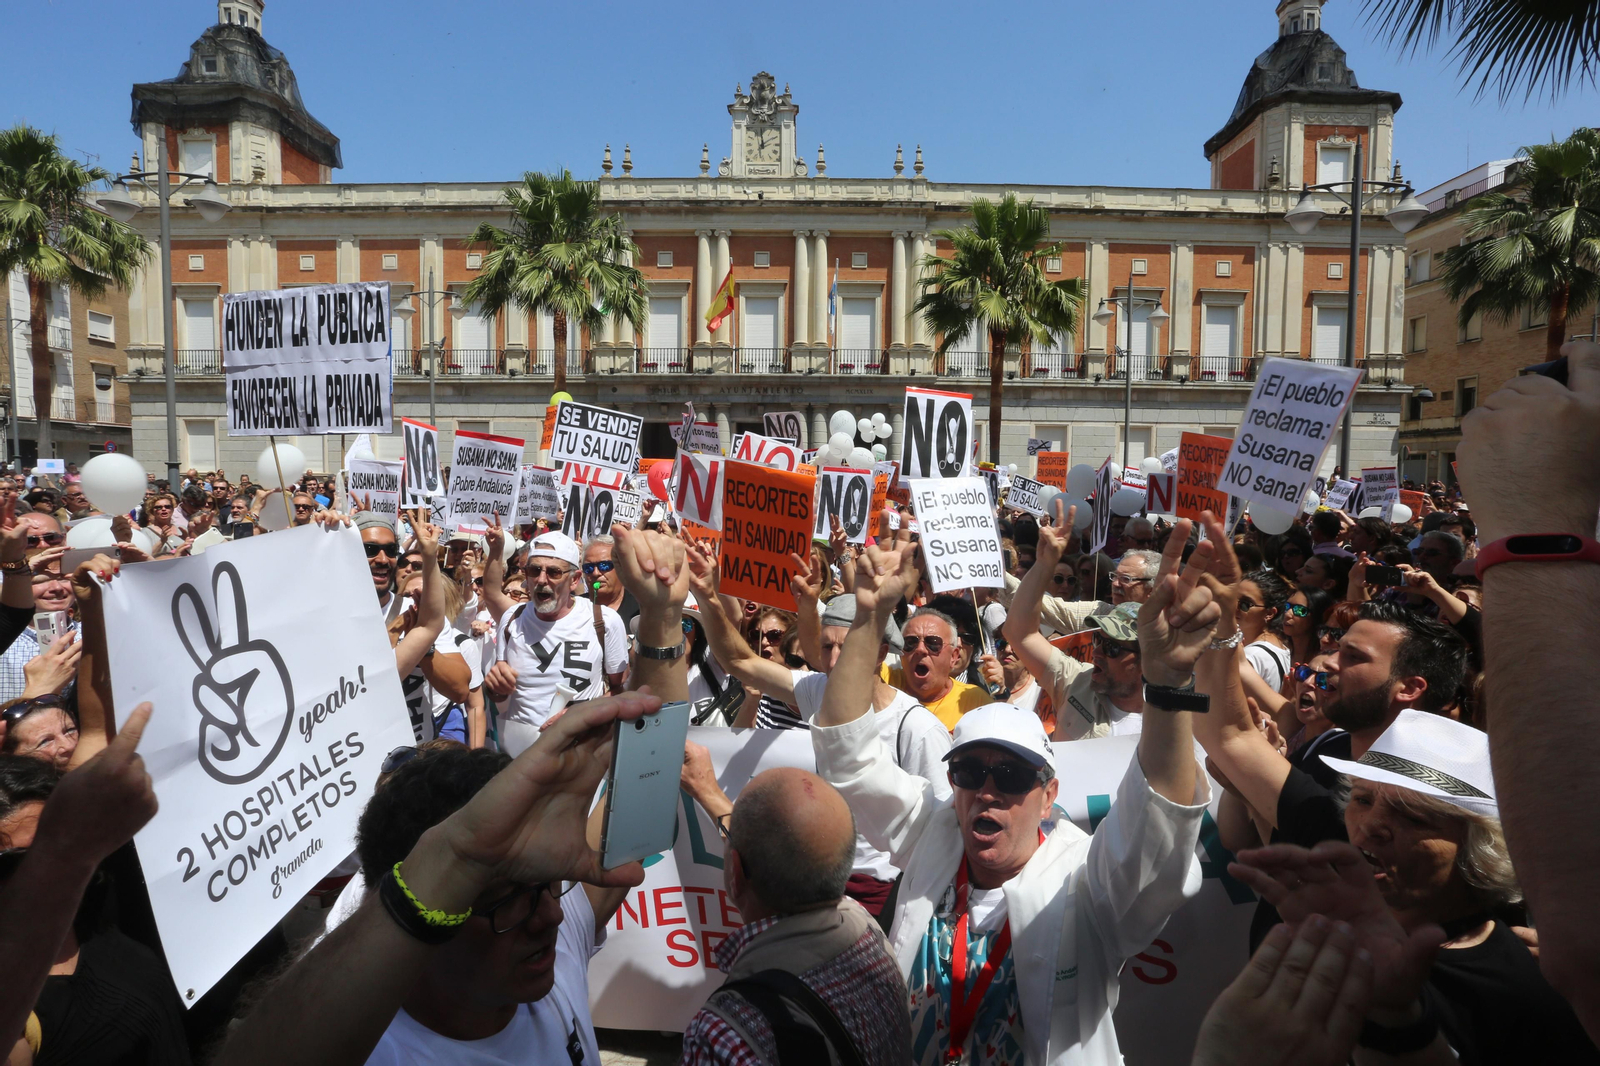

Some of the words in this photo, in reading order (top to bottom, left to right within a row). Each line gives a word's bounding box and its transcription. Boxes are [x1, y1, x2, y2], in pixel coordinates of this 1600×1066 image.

[225, 297, 283, 351] HUNDEN
[291, 296, 309, 347] LA
[317, 290, 386, 346] PUBLICA
[232, 376, 299, 430] FAVORECEN
[303, 374, 320, 427] LA
[326, 373, 384, 427] PRIVADA
[719, 387, 805, 395] AYUNTAMIENTO
[1257, 374, 1285, 399] ¡El
[1281, 381, 1344, 408] pueblo
[560, 406, 582, 426] SE
[587, 411, 640, 438] VENDE
[765, 413, 802, 448] NO
[902, 396, 967, 478] NO
[1248, 408, 1331, 440] reclama:
[404, 425, 438, 492] NO
[457, 446, 486, 467] SUSANA
[485, 449, 497, 468] NO
[497, 451, 518, 472] SANA.
[558, 429, 579, 455] TU
[581, 434, 633, 464] SALUD
[736, 434, 795, 472] NO
[1038, 456, 1067, 466] RECORTES
[1238, 433, 1315, 472] Susana
[351, 472, 375, 489] SUSANA
[376, 474, 384, 490] NO
[451, 476, 475, 495] ¡Pobre
[476, 477, 513, 495] Andalucía
[1014, 477, 1023, 488] SE
[1025, 480, 1044, 495] VEN
[1037, 464, 1044, 476] EN
[1044, 468, 1066, 477] SANIDAD
[1178, 467, 1190, 485] EN
[1192, 469, 1218, 491] SANID
[1225, 461, 1252, 487] NO
[1253, 475, 1306, 504] sana!
[1364, 474, 1378, 483] SUSANA
[1379, 473, 1384, 481] NO
[371, 499, 396, 514] Andalucía
[450, 502, 455, 518] y
[455, 498, 478, 517] España
[478, 502, 491, 514] con
[614, 504, 635, 518] ALUD
[619, 491, 640, 505] ENDE
[726, 478, 809, 520] RECORTES
[816, 474, 868, 538] NO
[918, 490, 938, 513] ¡El
[941, 488, 986, 510] pueblo
[1009, 489, 1020, 502] TU
[562, 485, 613, 540] NO
[923, 513, 993, 533] reclama:
[724, 517, 742, 544] EN
[746, 521, 806, 559] SANIDAD
[929, 539, 998, 557] Susana
[723, 554, 799, 594] MATAN
[934, 562, 963, 583] NO
[968, 560, 1002, 578] sana!
[299, 665, 367, 743] yeah!
[639, 770, 661, 780] SONY
[176, 846, 200, 883] 2
[201, 732, 365, 860] HOSPITALES
[207, 771, 357, 903] COMPLETOS
[271, 838, 324, 900] granada
